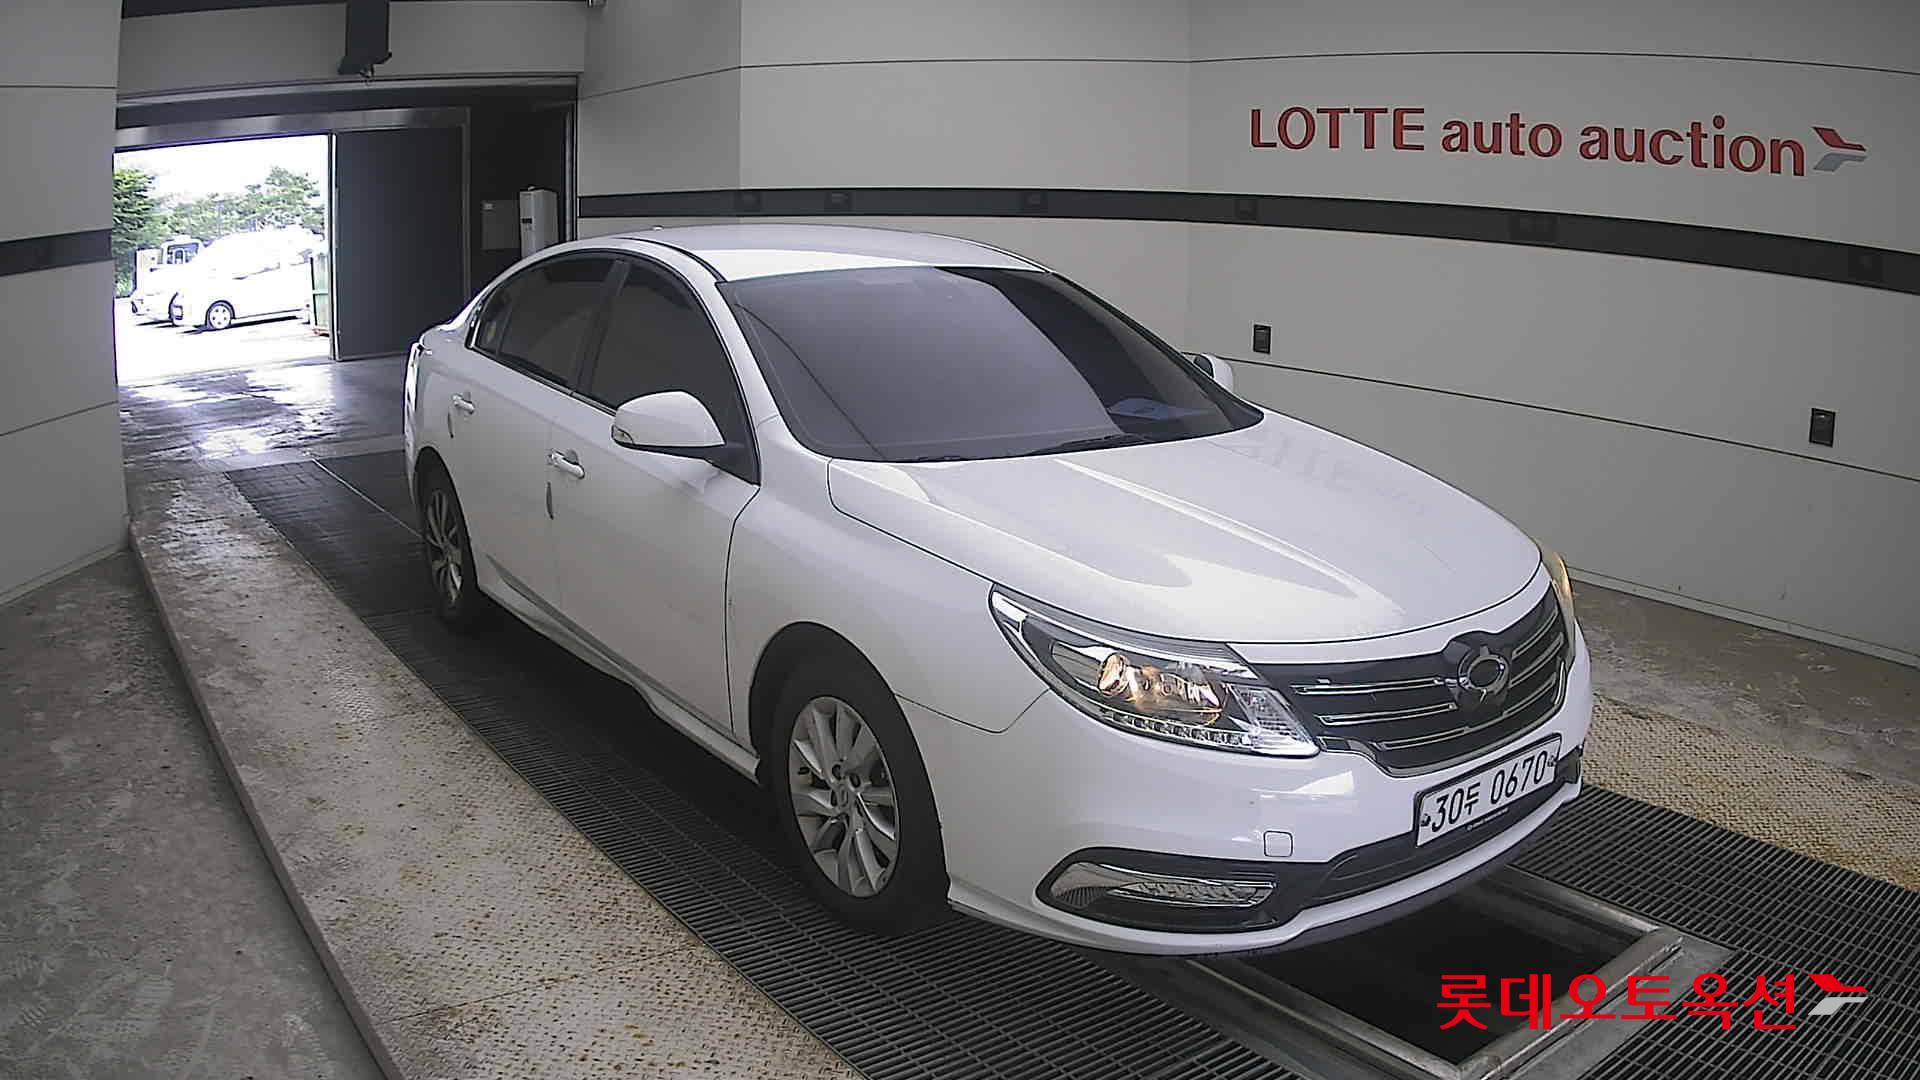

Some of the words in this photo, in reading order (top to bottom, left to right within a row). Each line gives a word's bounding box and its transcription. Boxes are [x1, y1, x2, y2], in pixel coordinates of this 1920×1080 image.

[1250, 106, 1426, 151] LOTTE
[1441, 112, 1562, 158] auto
[1579, 115, 1806, 177] auction
[1431, 781, 1481, 833] 30두
[1490, 750, 1548, 804] 0670
